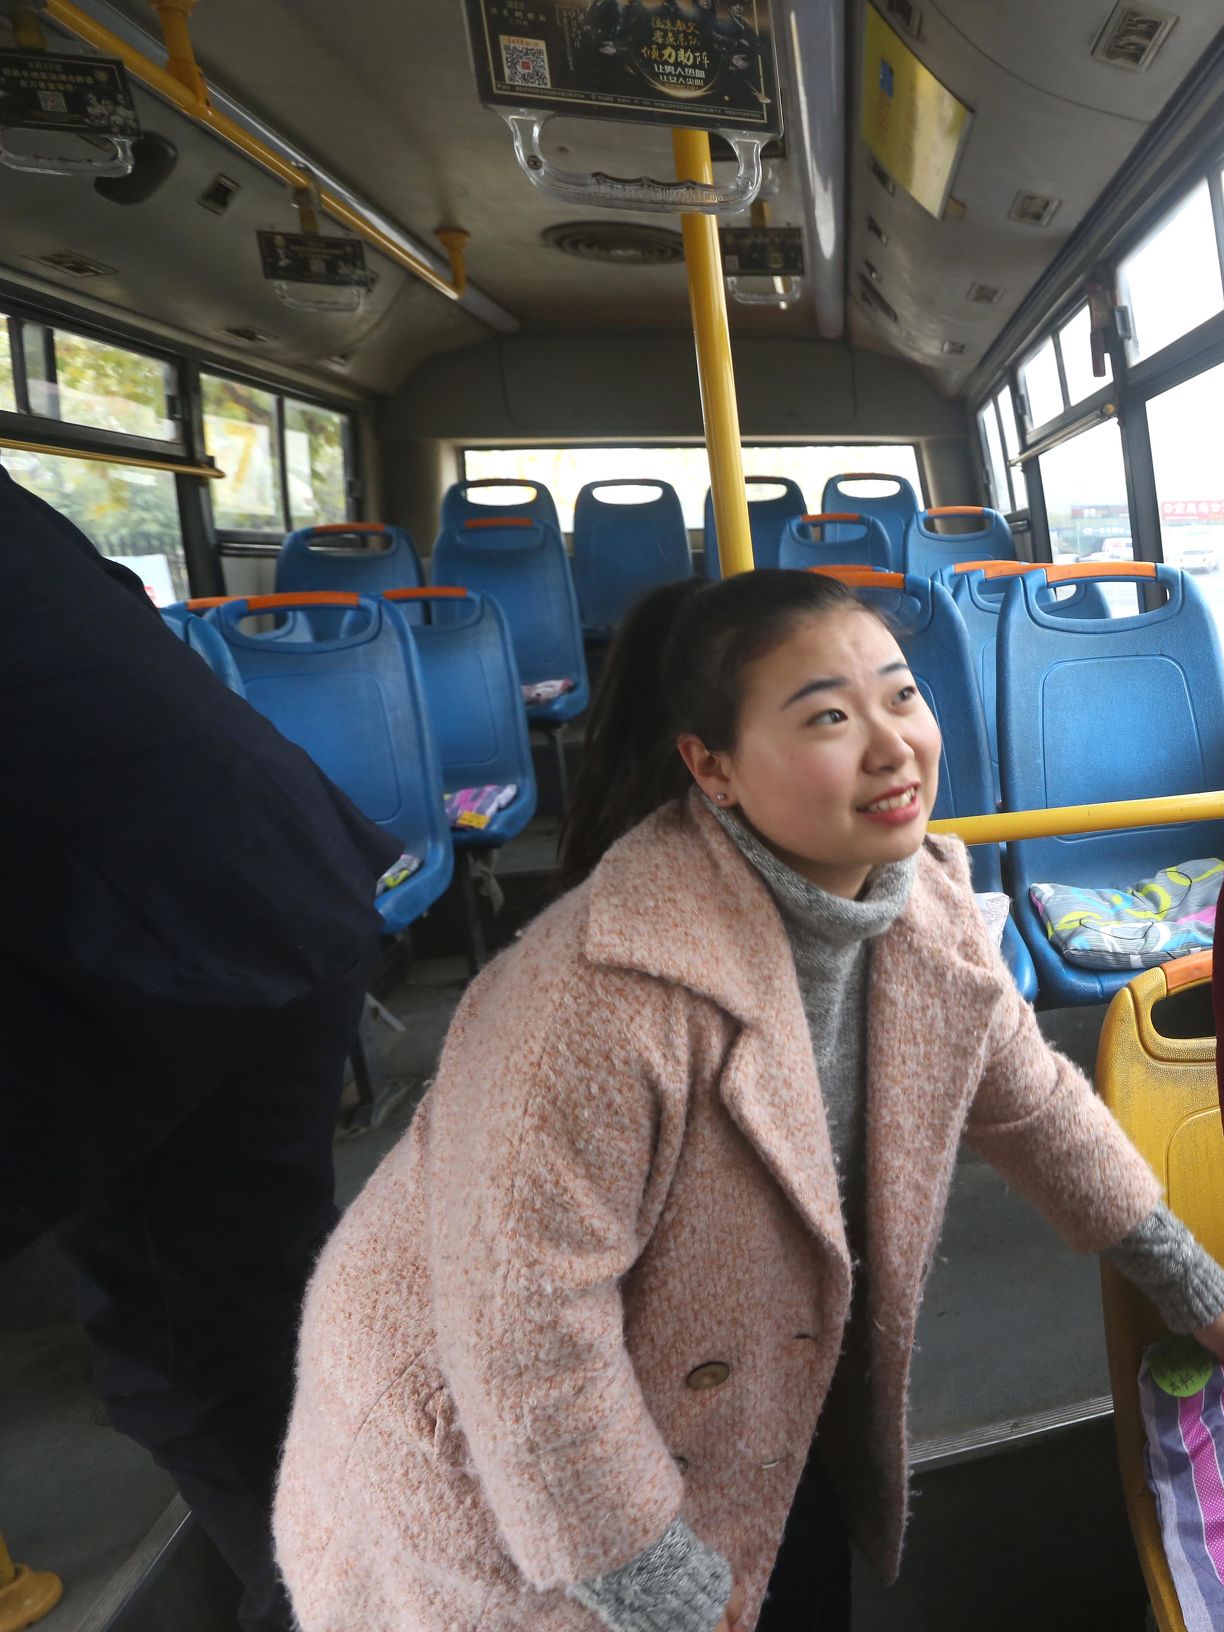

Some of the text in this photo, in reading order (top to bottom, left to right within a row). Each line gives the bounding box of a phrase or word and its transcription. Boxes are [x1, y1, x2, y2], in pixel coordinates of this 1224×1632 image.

[641, 45, 710, 69] 倾力助阵
[654, 63, 706, 79] 让男人热血
